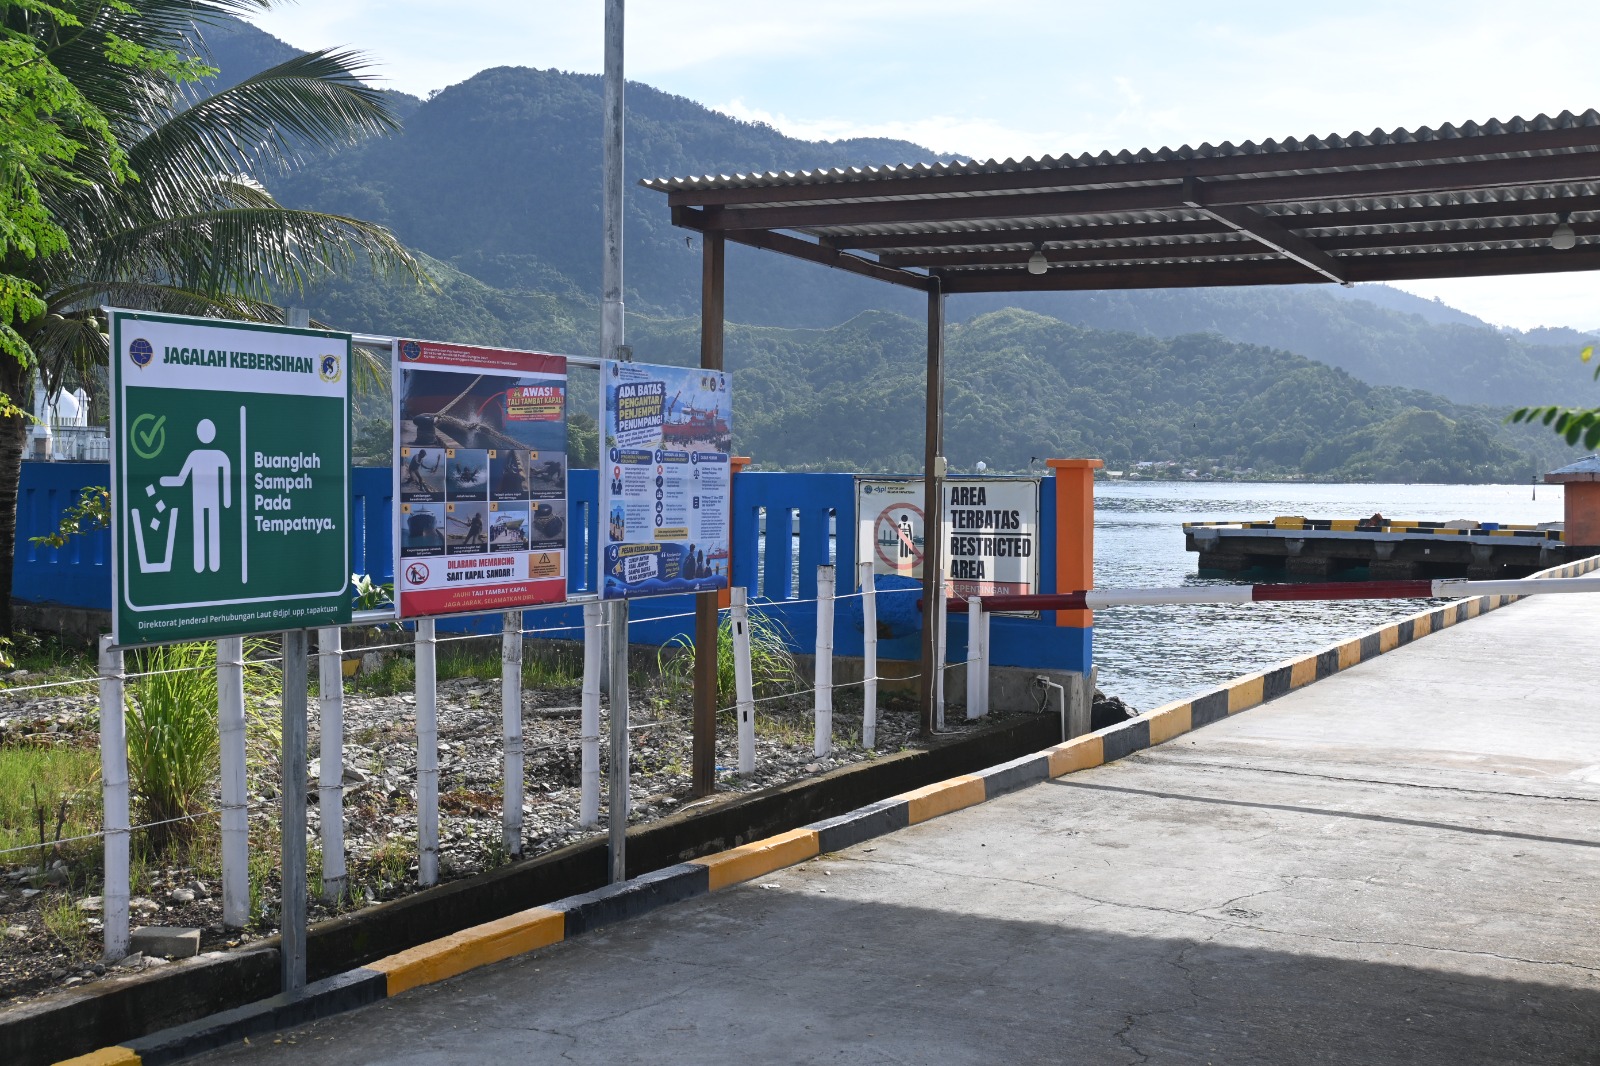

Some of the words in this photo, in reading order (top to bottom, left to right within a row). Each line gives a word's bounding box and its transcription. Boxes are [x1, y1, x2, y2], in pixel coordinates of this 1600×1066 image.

[163, 346, 227, 368] JAGALAH
[229, 351, 314, 374] KEBERSIHAN
[522, 387, 553, 397] AWAS!
[618, 385, 636, 398] ADA
[637, 383, 662, 396] BATAS
[508, 398, 520, 406] TALI
[521, 397, 544, 405] TAMBAT
[544, 396, 564, 404] KAPAL!
[619, 395, 662, 409] PENGANTAR/
[619, 405, 661, 420] PENJEMPUT
[618, 415, 663, 432] PENUMPANG!
[254, 451, 321, 473] Buanglah
[612, 451, 616, 460] 1
[656, 452, 661, 461] 2
[692, 453, 697, 462] 3
[254, 473, 313, 493] Sampah
[254, 494, 291, 511] Pada
[950, 486, 987, 506] AREA
[254, 515, 336, 535] Tempatnya.
[950, 509, 1020, 530] TERBATAS
[611, 548, 616, 558] 4
[950, 536, 1032, 558] RESTRICTED
[447, 559, 477, 570] DILARANG
[478, 557, 515, 567] MEMANCING
[950, 559, 986, 579] AREA
[446, 571, 463, 582] SAAT
[465, 570, 485, 580] KAPAL
[484, 588, 508, 596] TAMBAT
[509, 586, 528, 594] KAPAL
[484, 596, 522, 604] SELAMATKAN
[138, 618, 178, 630] Direktorat
[178, 616, 209, 628] Jenderal
[209, 611, 256, 623] Perhubungan
[256, 609, 272, 620] Laut
[272, 605, 338, 618] @djpl_upp_tapaktuan
